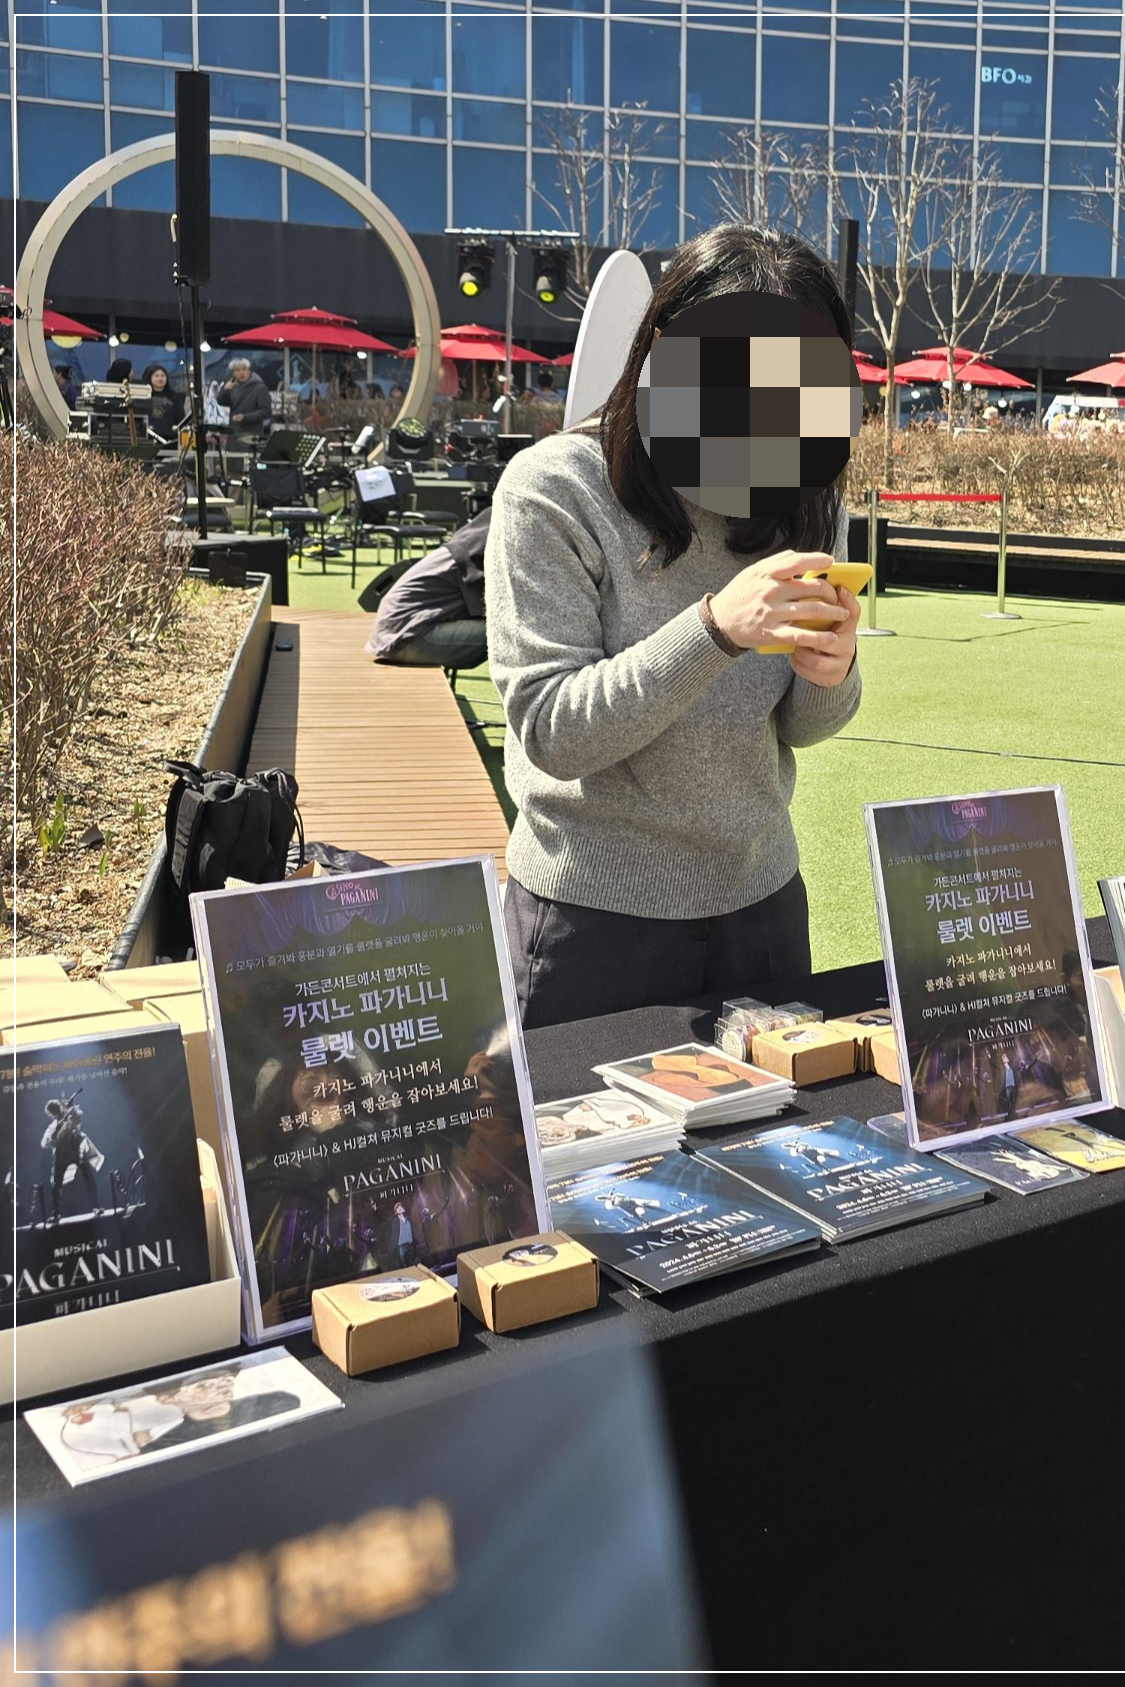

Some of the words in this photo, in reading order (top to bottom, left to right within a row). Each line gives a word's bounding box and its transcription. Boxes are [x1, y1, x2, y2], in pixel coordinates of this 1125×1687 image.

[325, 882, 354, 900] CASINO
[933, 870, 990, 889] 가든콘서트에서
[991, 867, 1023, 882] 펼쳐지는
[340, 887, 379, 906] PAGANINI
[925, 890, 973, 913] 카지노
[975, 879, 1035, 906] 파가니니
[937, 916, 975, 945] 룰렛
[978, 909, 1032, 937] 이벤트
[236, 957, 265, 972] 모두가
[268, 953, 296, 967] 즐겨봐
[297, 948, 325, 963] 흥분과
[327, 943, 355, 958] 열기를
[946, 953, 976, 969] 카지노
[976, 943, 1032, 964] 파가니니에서
[295, 970, 382, 998] 가든콘서트에서
[383, 962, 432, 983] 펼쳐지는
[925, 976, 954, 993] 룰렛을
[956, 971, 976, 987] 굴려
[978, 967, 1007, 984] 행운을
[1008, 959, 1057, 979] 잡아보세요!
[283, 997, 355, 1030] 카지노
[358, 977, 449, 1015] 파가니니
[959, 1002, 967, 1012] &
[992, 993, 1013, 1005] 뮤지컬
[1014, 990, 1036, 1002] 굿즈를
[1037, 984, 1068, 998] 드립니다!
[300, 1029, 357, 1069] 룰렛
[363, 1015, 444, 1053] 이벤트
[967, 1018, 1033, 1043] PAGANINI
[103, 1050, 133, 1064] 연주의
[133, 1047, 156, 1060] 전율!
[313, 1078, 357, 1099] 카지노
[360, 1057, 443, 1089] 파가니니에서
[279, 1109, 324, 1133] 룰렛을
[328, 1101, 357, 1123] 굴려
[361, 1092, 404, 1115] 행운을
[406, 1075, 479, 1104] 잡아보세요!
[332, 1143, 341, 1154] &
[343, 1131, 379, 1151] HJ컬쳐
[380, 1124, 413, 1143] 뮤지컬
[415, 1117, 447, 1134] 굿즈를
[449, 1106, 494, 1127] 드립니다!
[343, 1153, 443, 1192] PAGANINI
[807, 1162, 926, 1199] PAGANINI
[54, 1238, 109, 1258] MUSICAL
[626, 1209, 756, 1257] PAGANINI
[54, 1289, 120, 1315] 파가니니
